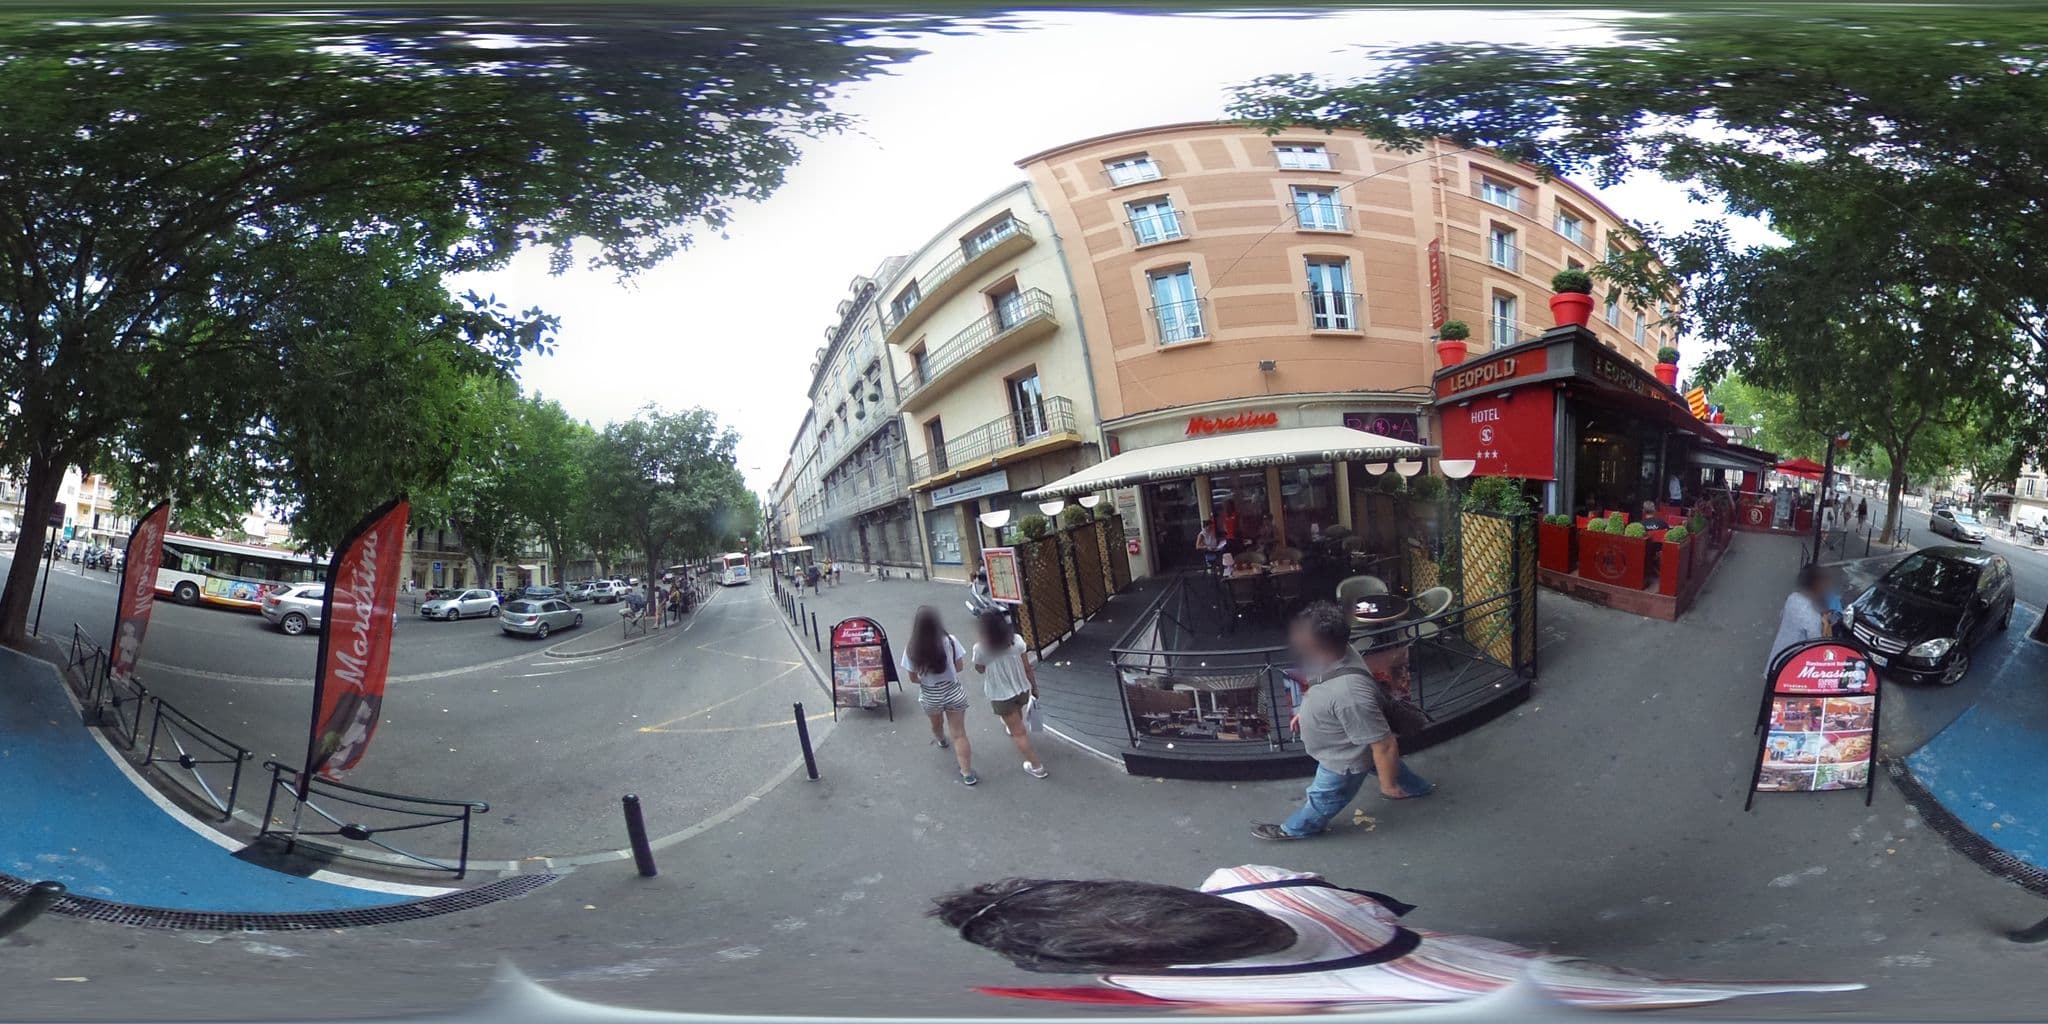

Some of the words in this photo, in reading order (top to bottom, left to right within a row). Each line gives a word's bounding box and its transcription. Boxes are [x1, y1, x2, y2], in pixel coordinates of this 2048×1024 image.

[1431, 279, 1441, 324] HOTEL
[1450, 358, 1516, 392] LEOPOLD
[1185, 411, 1279, 436] Marasino
[1471, 408, 1500, 424] HOTEL
[1322, 450, 1341, 462] 04
[1344, 449, 1361, 460] 42
[1367, 447, 1393, 459] 200
[1395, 446, 1421, 458] 200
[1148, 466, 1198, 481] Lounge
[1201, 462, 1226, 473] Bar
[1229, 458, 1241, 470] &
[1243, 454, 1297, 469] Pergola
[1039, 477, 1125, 498] RESTAURANT
[335, 530, 378, 690] Marasino
